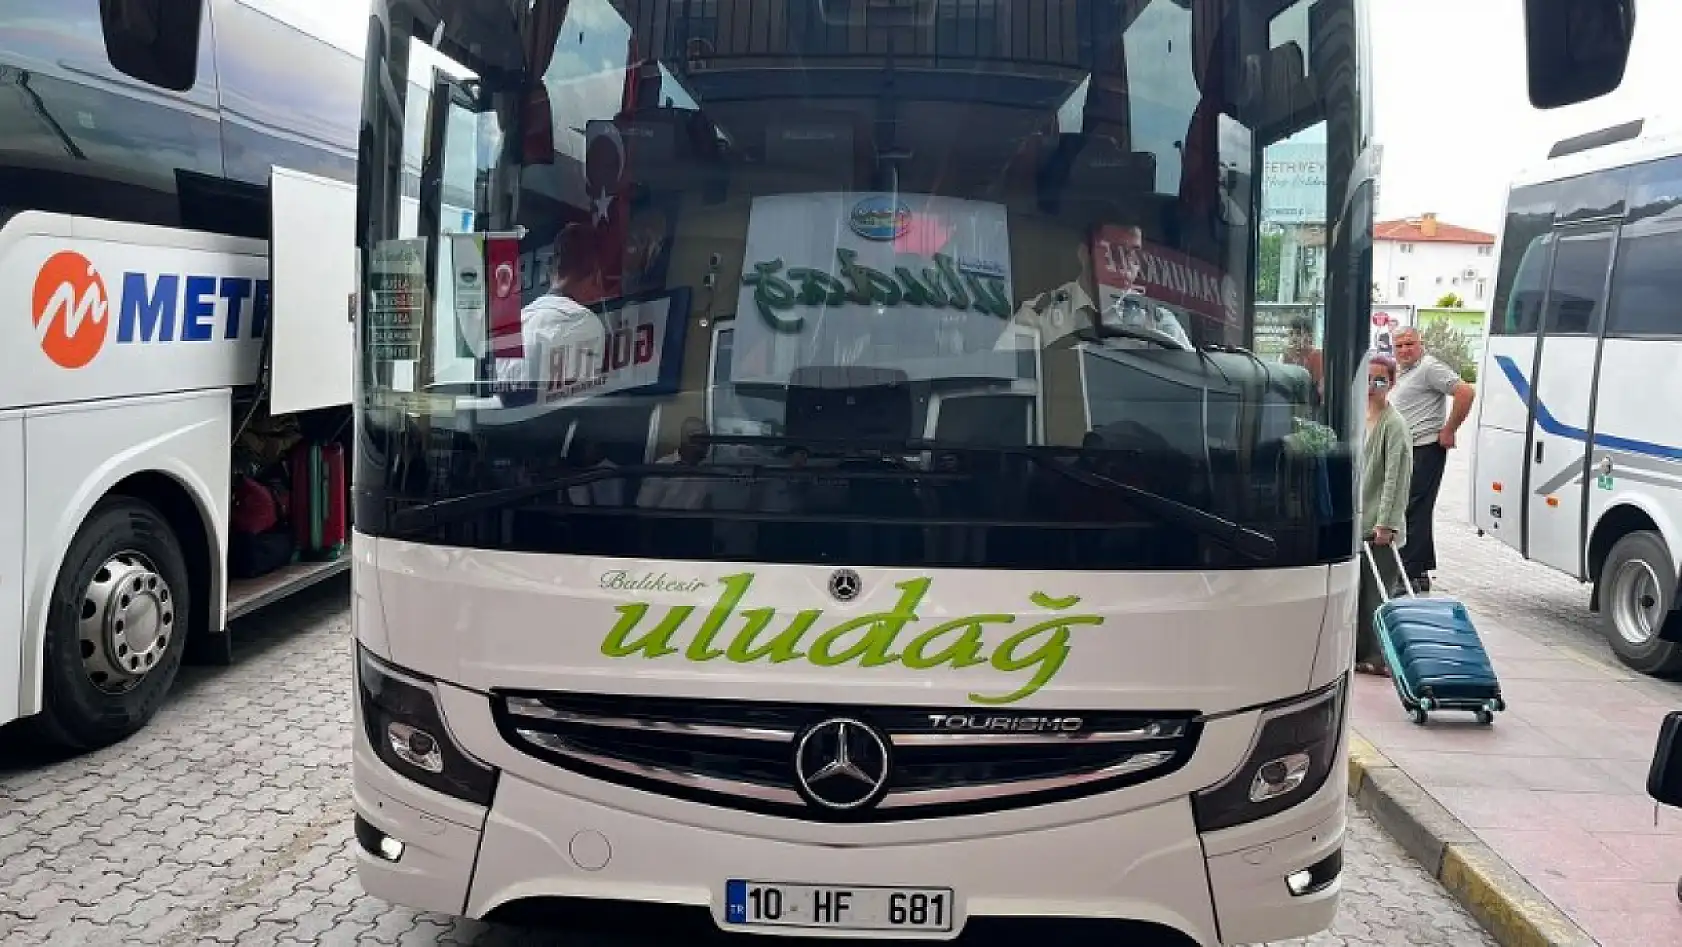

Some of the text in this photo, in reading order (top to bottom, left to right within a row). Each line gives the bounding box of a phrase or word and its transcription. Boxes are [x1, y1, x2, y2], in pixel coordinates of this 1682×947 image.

[600, 572, 1105, 704] uludağ
[928, 713, 1084, 732] TOURISMO
[749, 887, 944, 925] 10 HF 681
